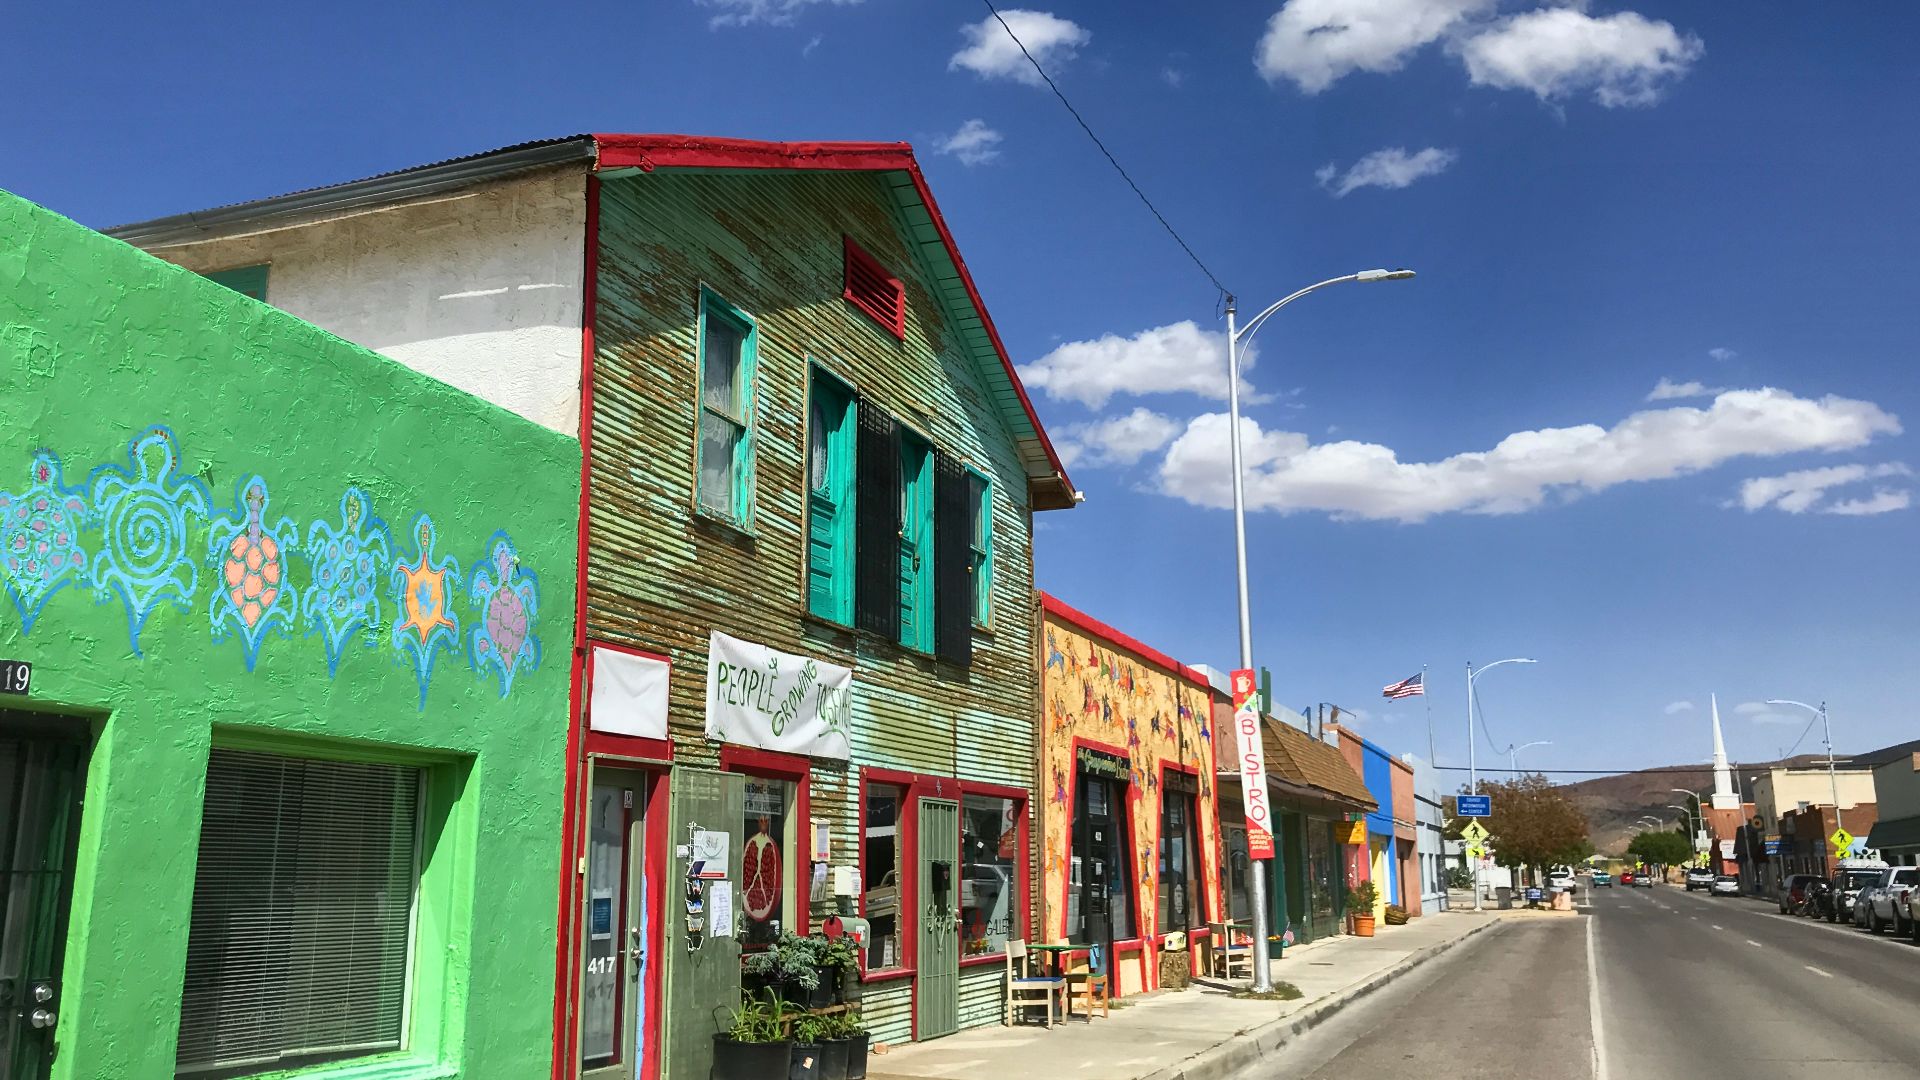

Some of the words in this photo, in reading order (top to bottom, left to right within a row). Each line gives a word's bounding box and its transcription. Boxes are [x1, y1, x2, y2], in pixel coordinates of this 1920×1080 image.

[4, 664, 30, 691] 19
[717, 661, 778, 714] PEOPLE
[771, 659, 818, 737] GROWING
[1241, 718, 1267, 822] BISTRO
[587, 956, 616, 975] 417
